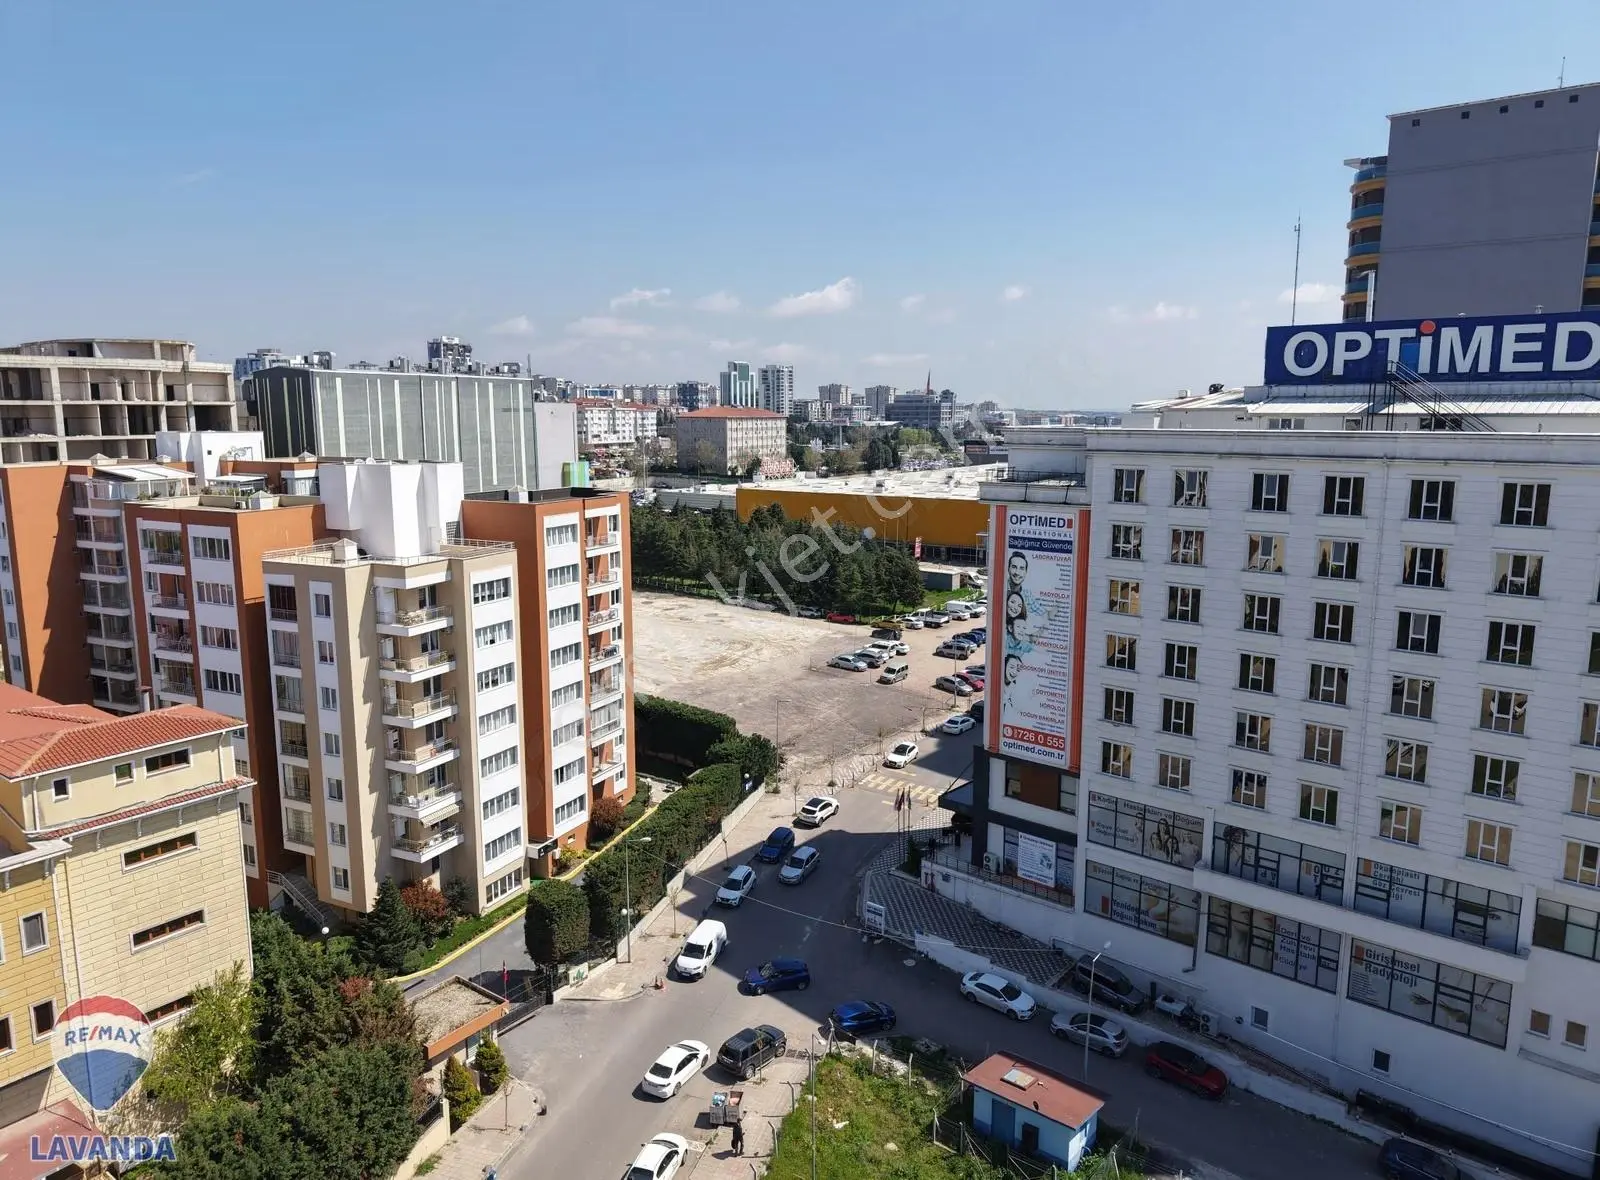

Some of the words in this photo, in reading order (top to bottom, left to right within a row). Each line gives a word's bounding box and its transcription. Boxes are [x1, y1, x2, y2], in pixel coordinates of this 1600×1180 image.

[1018, 729, 1035, 742] 726
[1037, 734, 1044, 744] 0
[1046, 736, 1065, 748] 555
[1002, 740, 1065, 760] optimed.com.tr
[1365, 948, 1420, 974] Girişmsel
